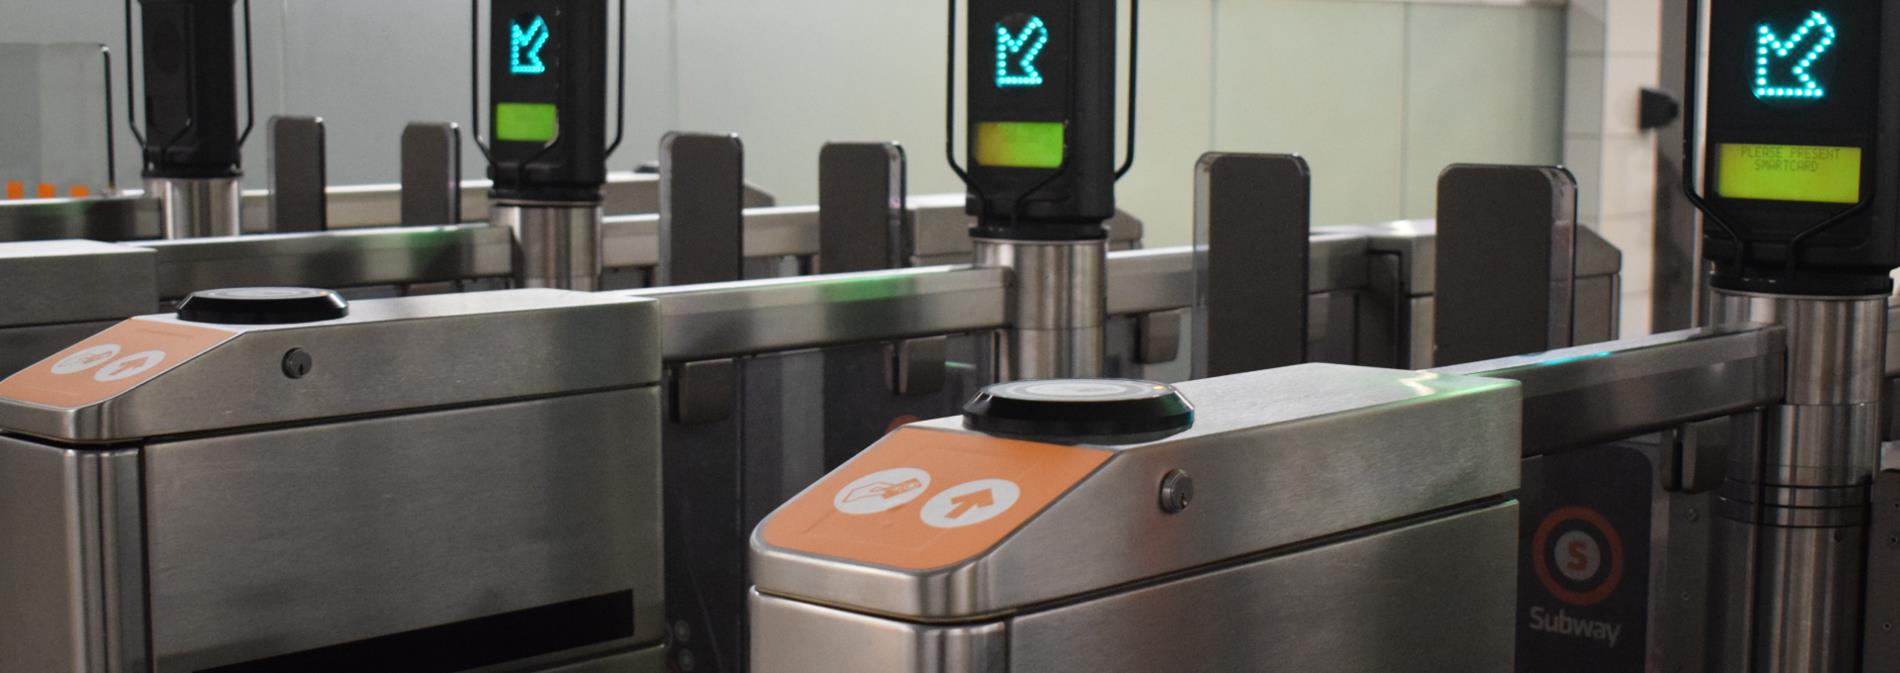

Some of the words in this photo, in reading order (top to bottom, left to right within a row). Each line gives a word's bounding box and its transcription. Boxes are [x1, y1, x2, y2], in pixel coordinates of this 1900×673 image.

[1740, 147, 1783, 159] PLEASE
[1790, 148, 1840, 160] PRESENT
[1754, 160, 1818, 172] SMARTCARD
[1567, 540, 1588, 571] S
[1529, 606, 1621, 647] Subway
